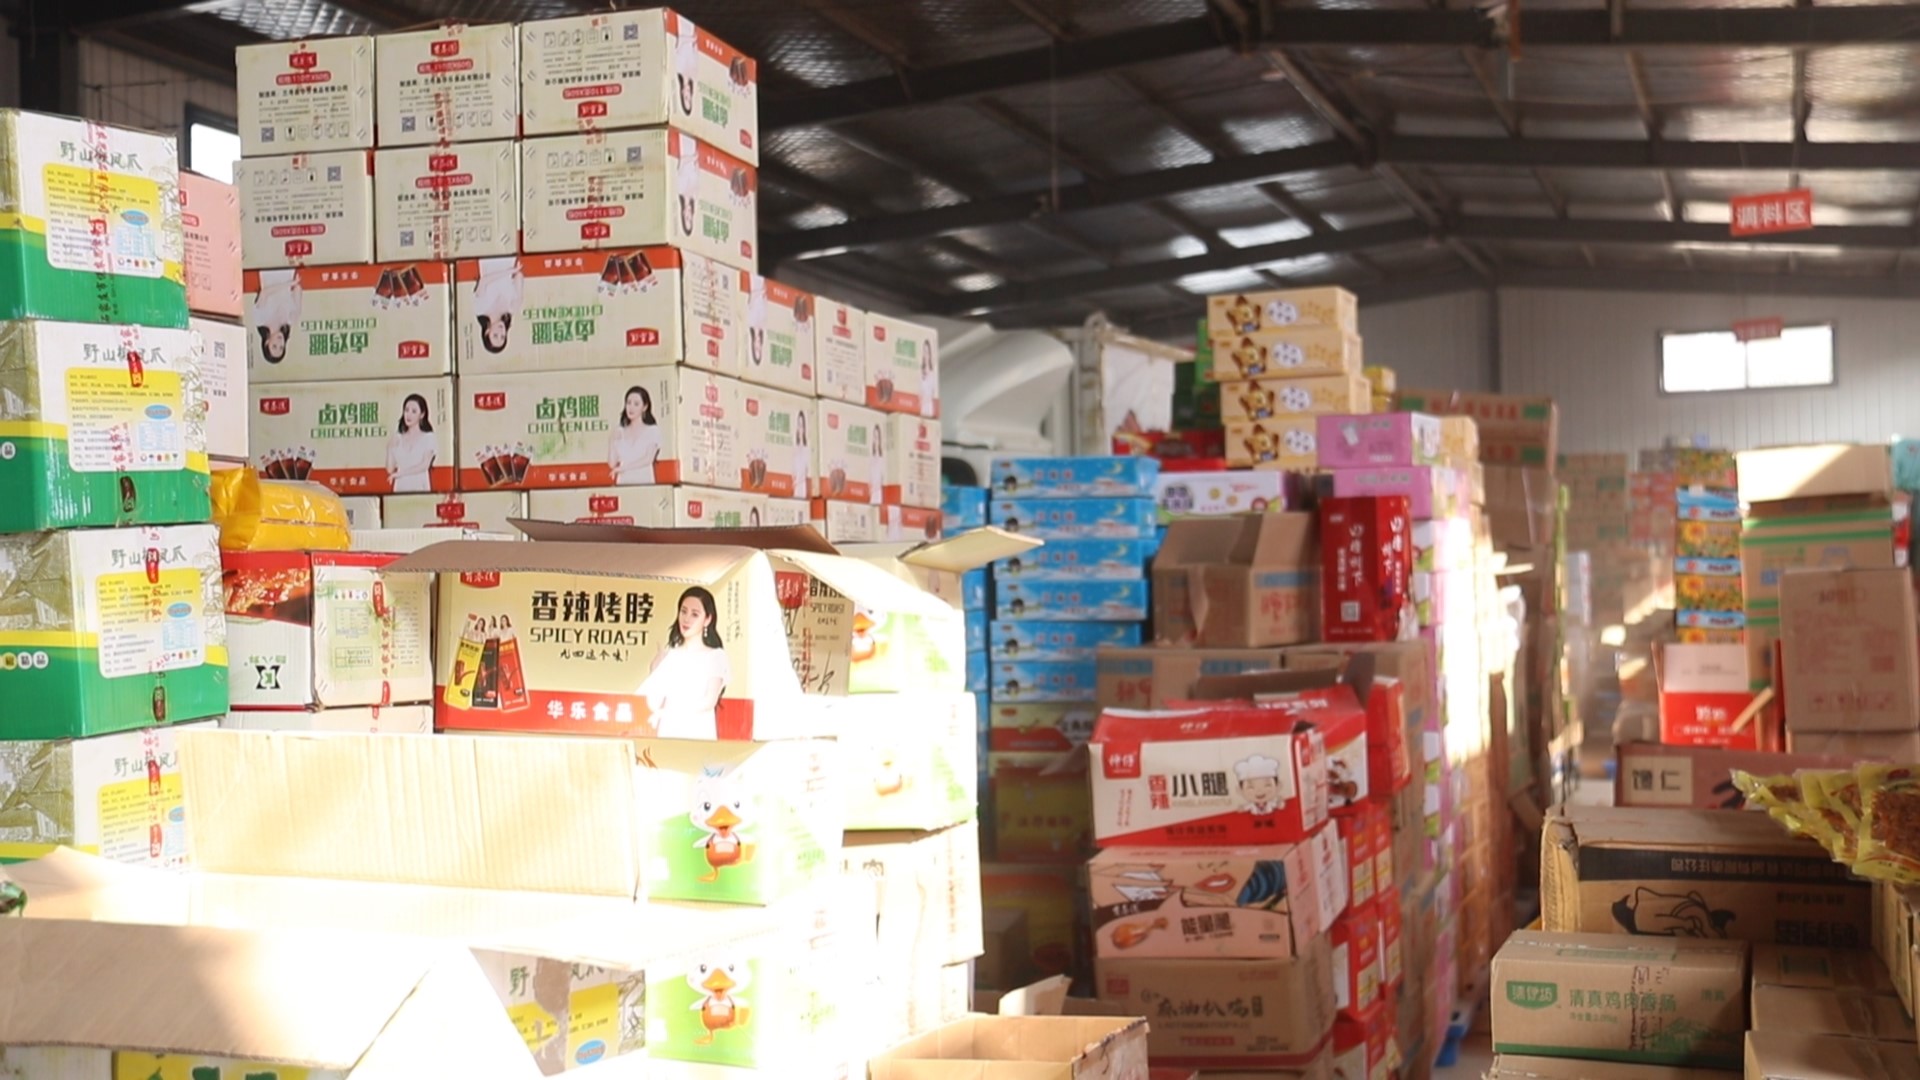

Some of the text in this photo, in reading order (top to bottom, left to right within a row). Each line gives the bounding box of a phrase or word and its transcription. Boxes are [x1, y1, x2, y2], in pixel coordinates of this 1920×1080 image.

[1736, 199, 1808, 229] 调料区
[309, 331, 369, 355] 卤鸡腿
[532, 319, 595, 344] 卤鸡腿
[318, 401, 379, 425] 卤鸡腿
[536, 394, 599, 420] 卤鸡腿
[531, 590, 655, 625] 香辣烤脖
[530, 626, 650, 646] SPICY ROAST
[547, 701, 635, 724] 华乐食品
[1171, 771, 1230, 798] 小腿
